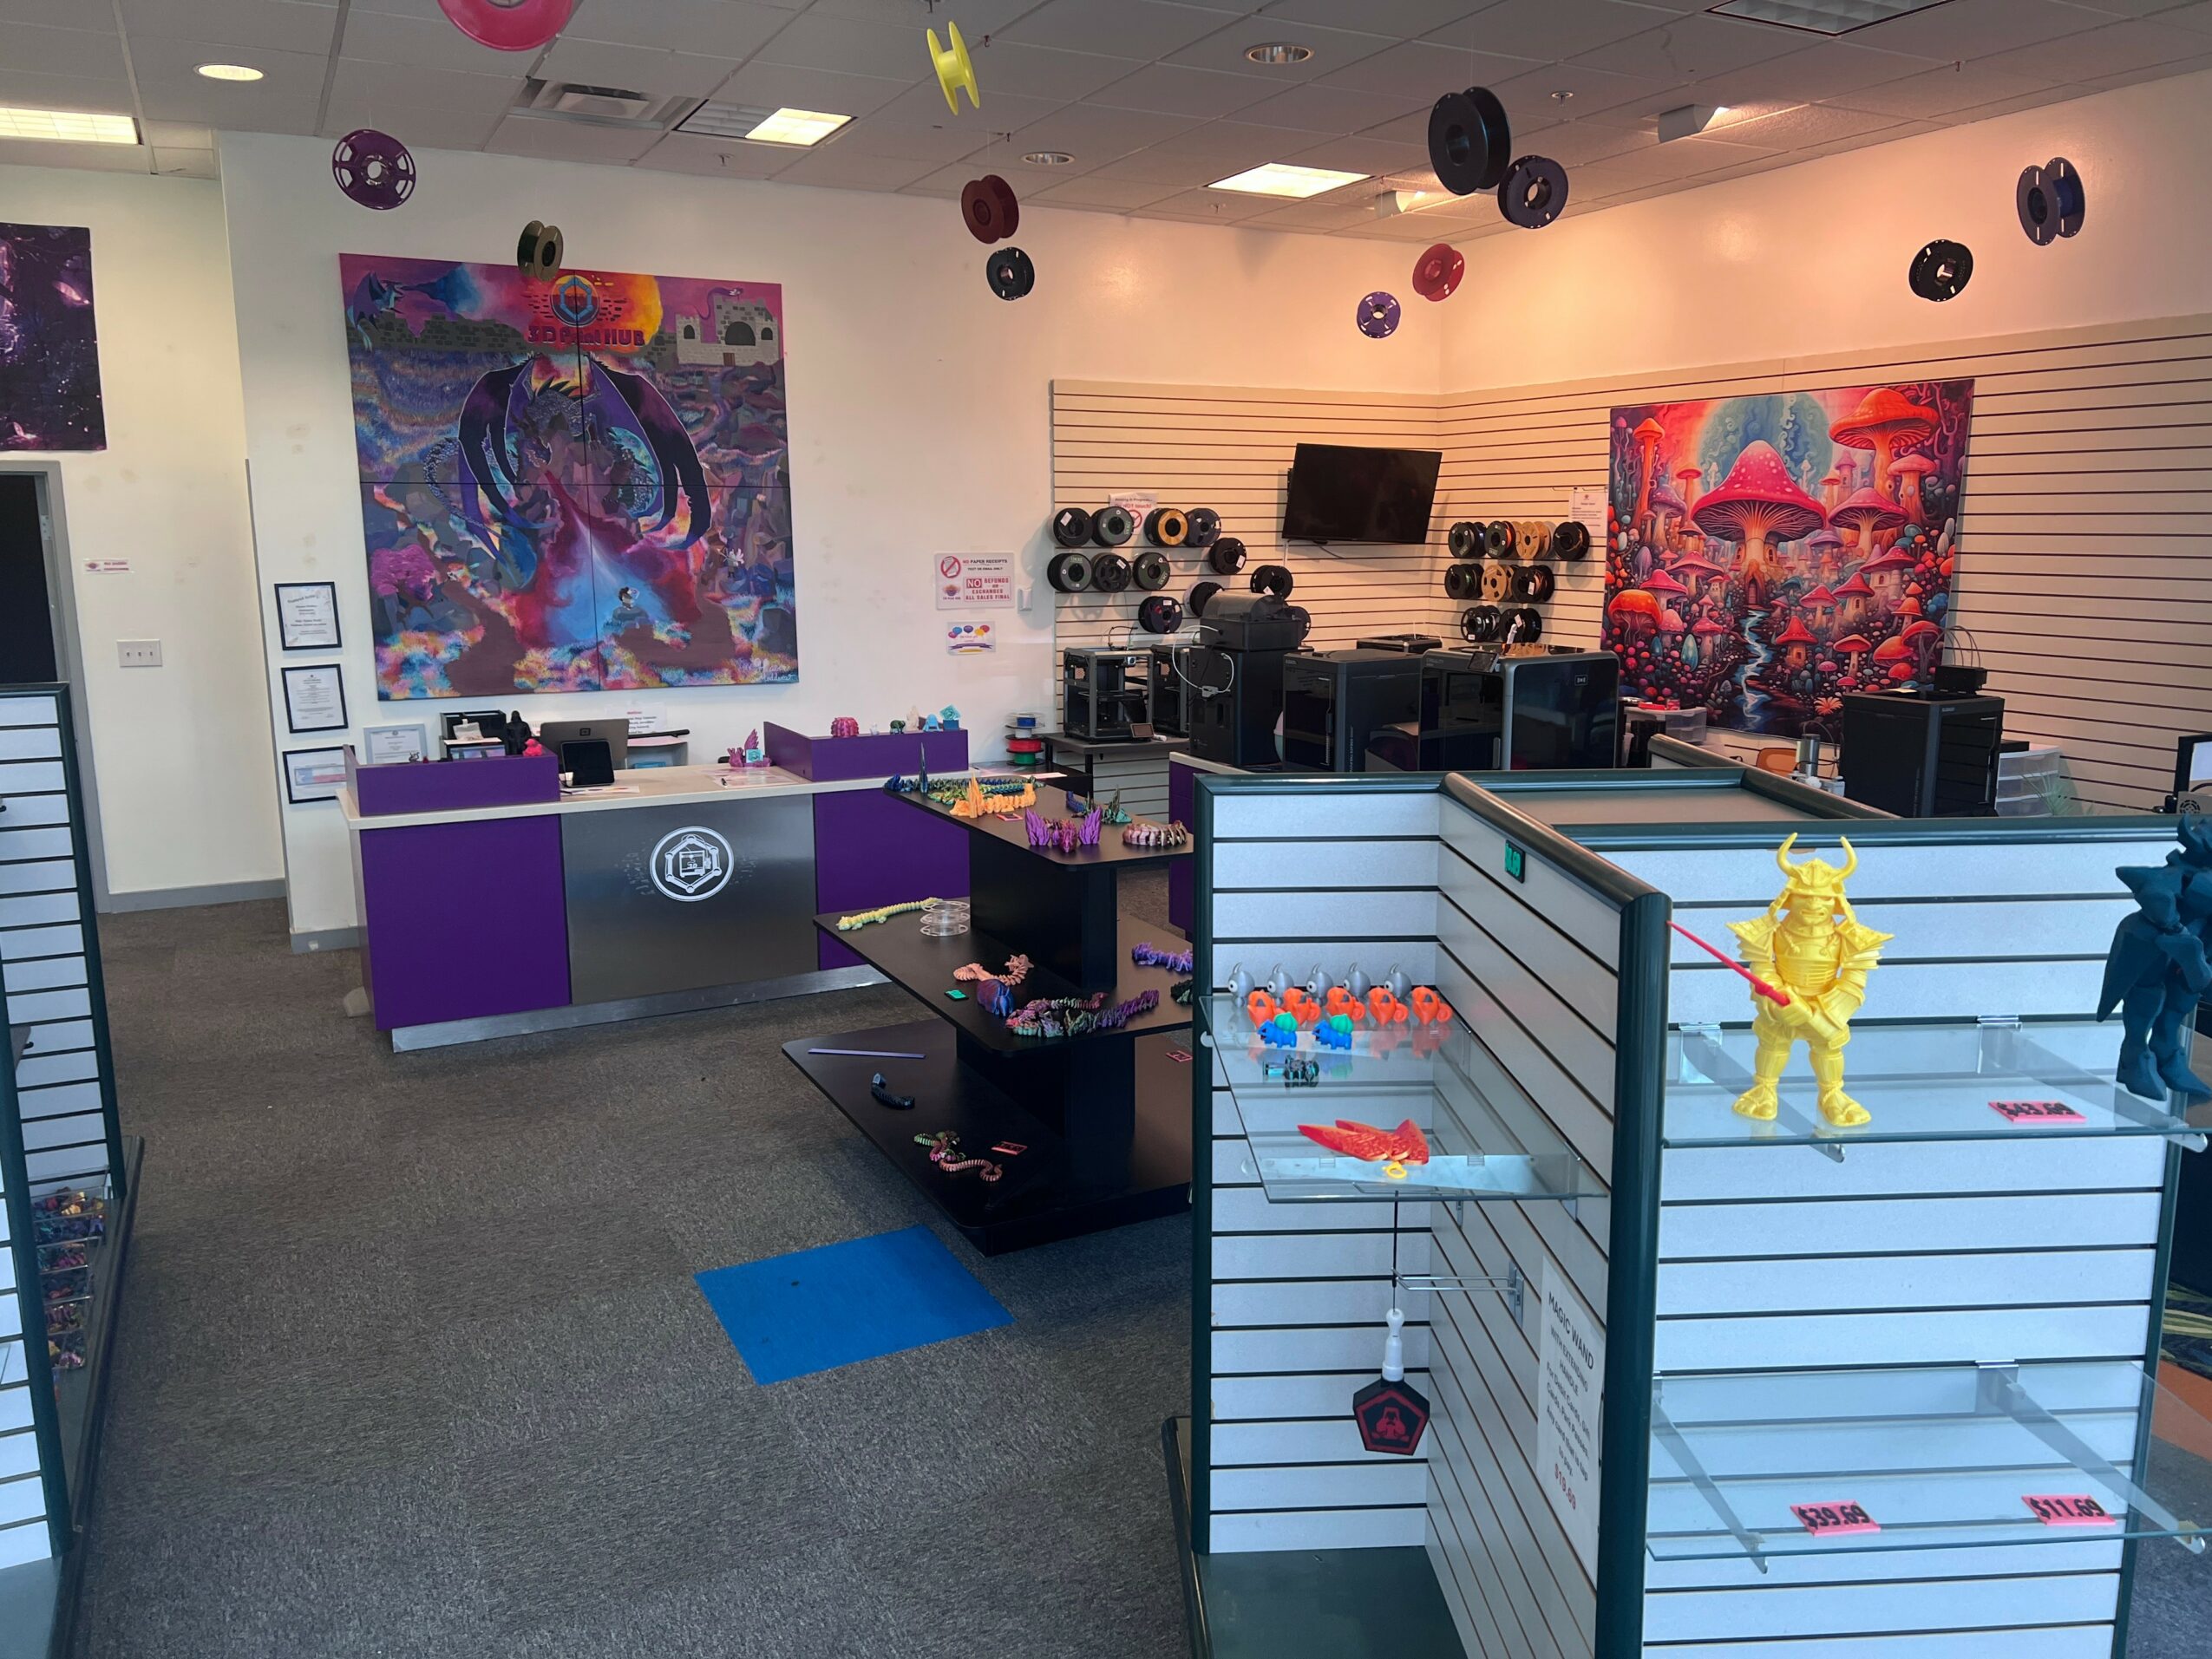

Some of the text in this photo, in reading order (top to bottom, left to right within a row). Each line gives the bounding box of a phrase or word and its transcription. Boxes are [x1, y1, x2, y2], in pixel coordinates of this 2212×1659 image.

[527, 325, 556, 345] 3D
[604, 328, 645, 348] HUB
[967, 578, 981, 588] NO
[1548, 1290, 1594, 1370] MAGIC WAND
[1550, 1324, 1588, 1393] WITH EXTENDING
[1554, 1373, 1567, 1400] Debit
[1560, 1359, 1579, 1396] HANDLE
[1547, 1405, 1555, 1426] Any
[1554, 1421, 1566, 1441] card
[1561, 1405, 1571, 1428] Park
[1559, 1445, 1564, 1459] to
[1554, 1463, 1576, 1511] $19.69
[1797, 1506, 1870, 1531] $39.69
[2030, 1498, 2105, 1519] $11.69
